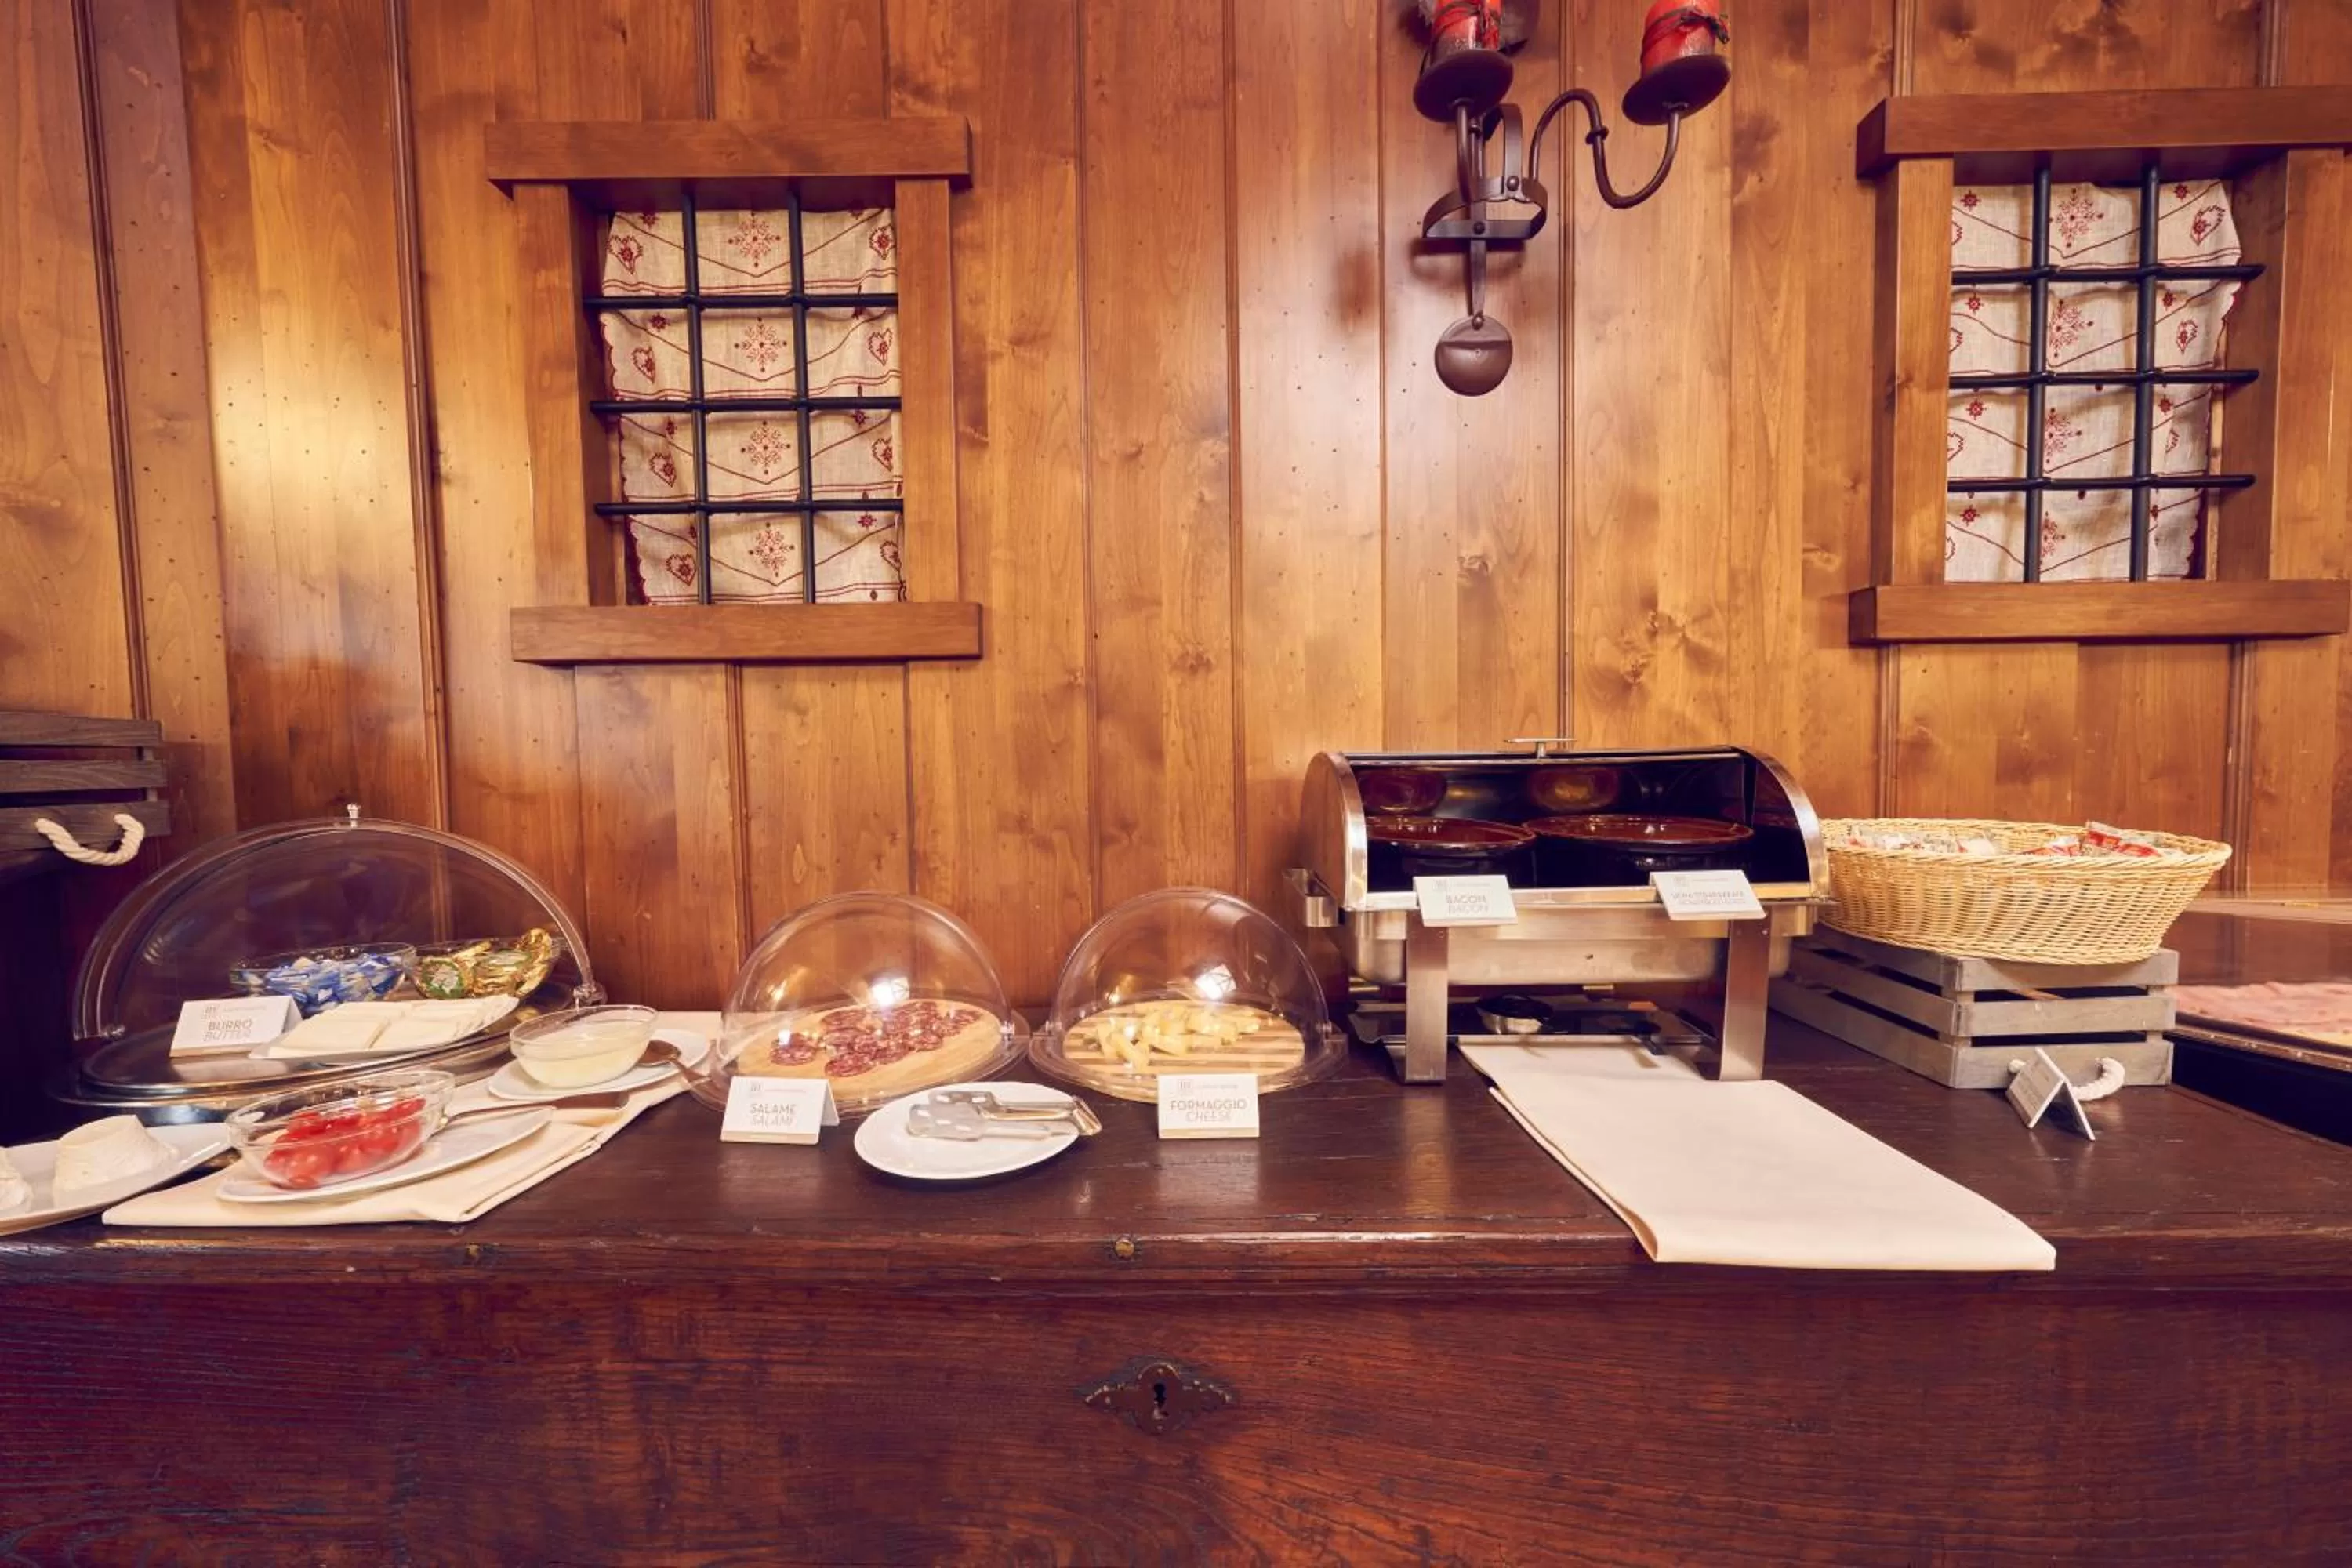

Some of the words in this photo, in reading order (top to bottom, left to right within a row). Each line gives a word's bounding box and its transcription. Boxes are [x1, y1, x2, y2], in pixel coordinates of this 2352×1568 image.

[208, 1018, 253, 1031] BURRO
[750, 1103, 797, 1116] SALAME
[1169, 1098, 1247, 1111] FORMAGGIO
